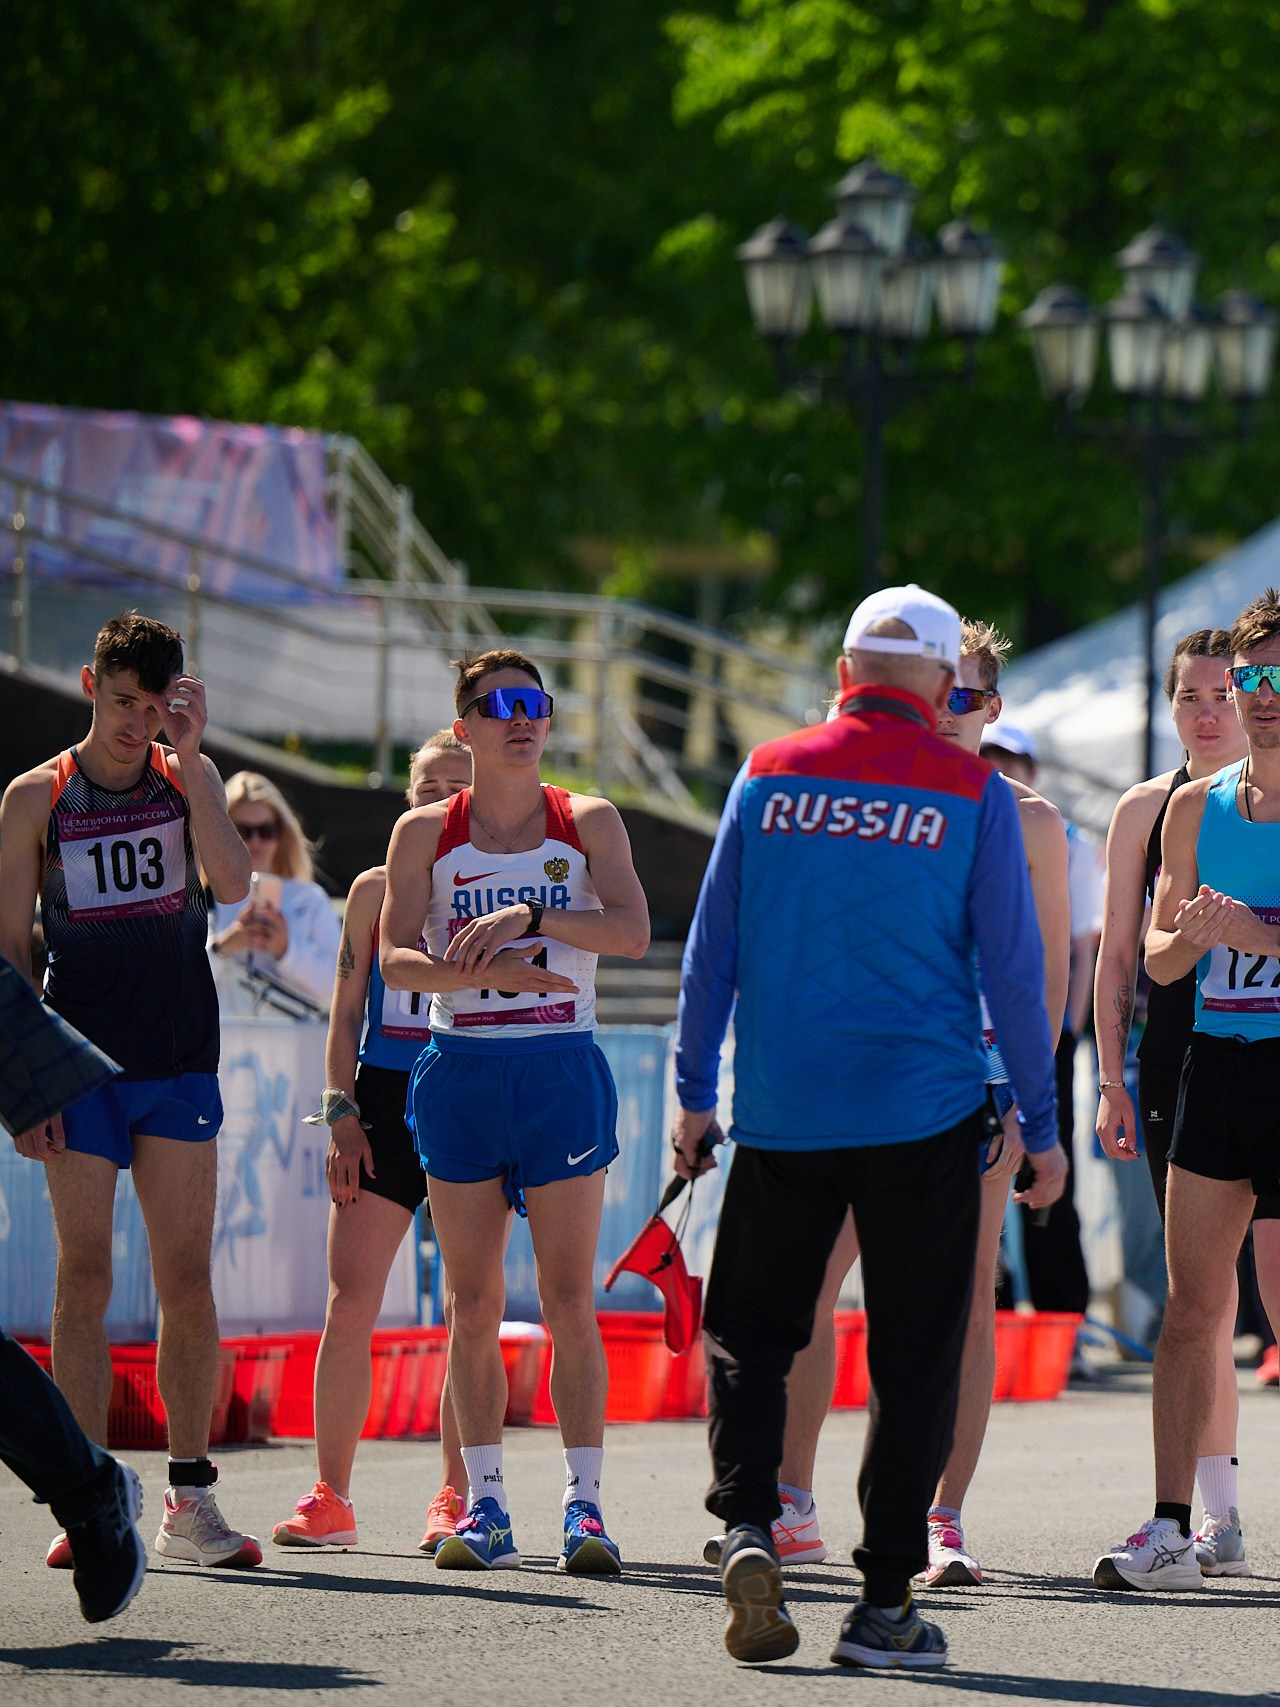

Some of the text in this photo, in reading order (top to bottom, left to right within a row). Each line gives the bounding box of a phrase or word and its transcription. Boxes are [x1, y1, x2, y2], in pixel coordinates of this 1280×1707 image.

[63, 810, 170, 828] ЧЕМПИОНАТ РОССИИ
[761, 792, 947, 850] RUSSIA
[87, 837, 165, 894] 103
